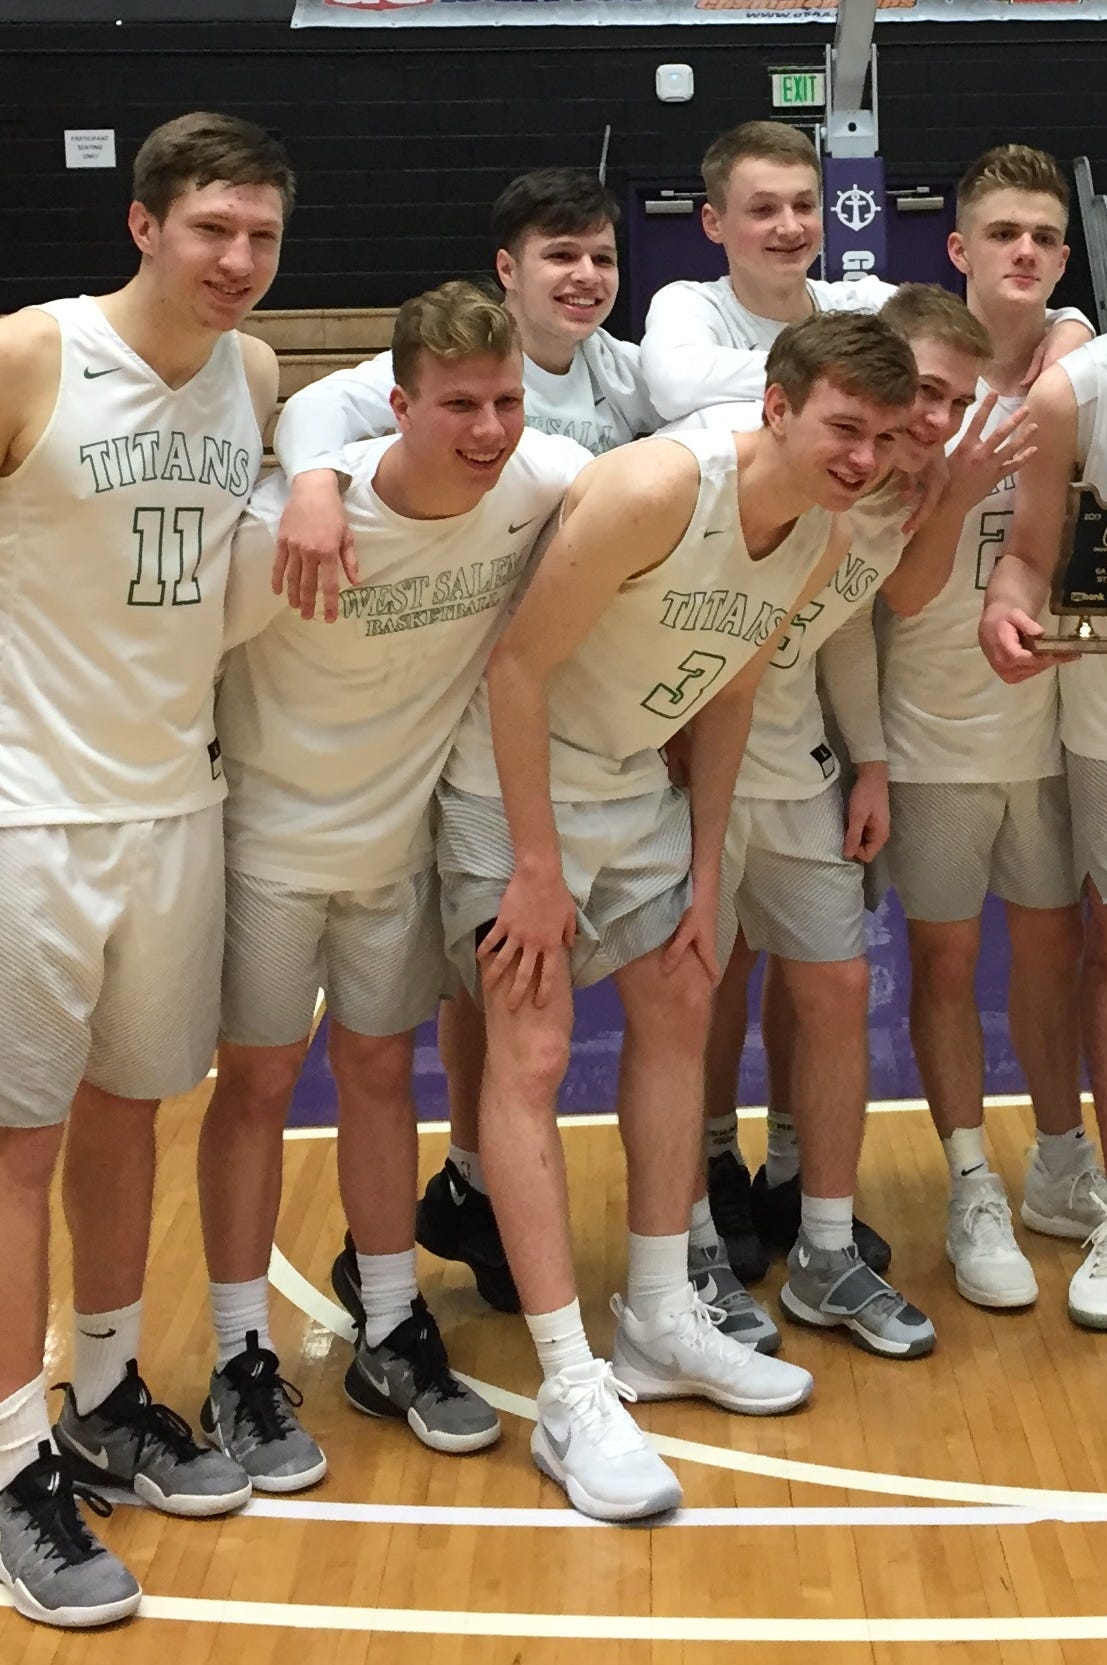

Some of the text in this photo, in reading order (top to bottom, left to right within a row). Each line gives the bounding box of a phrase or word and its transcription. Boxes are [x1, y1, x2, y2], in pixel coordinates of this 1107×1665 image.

[783, 75, 817, 102] EXIT
[80, 430, 250, 497] TITANS
[127, 507, 204, 606] 11
[338, 576, 430, 619] WEST
[640, 650, 726, 719] 3
